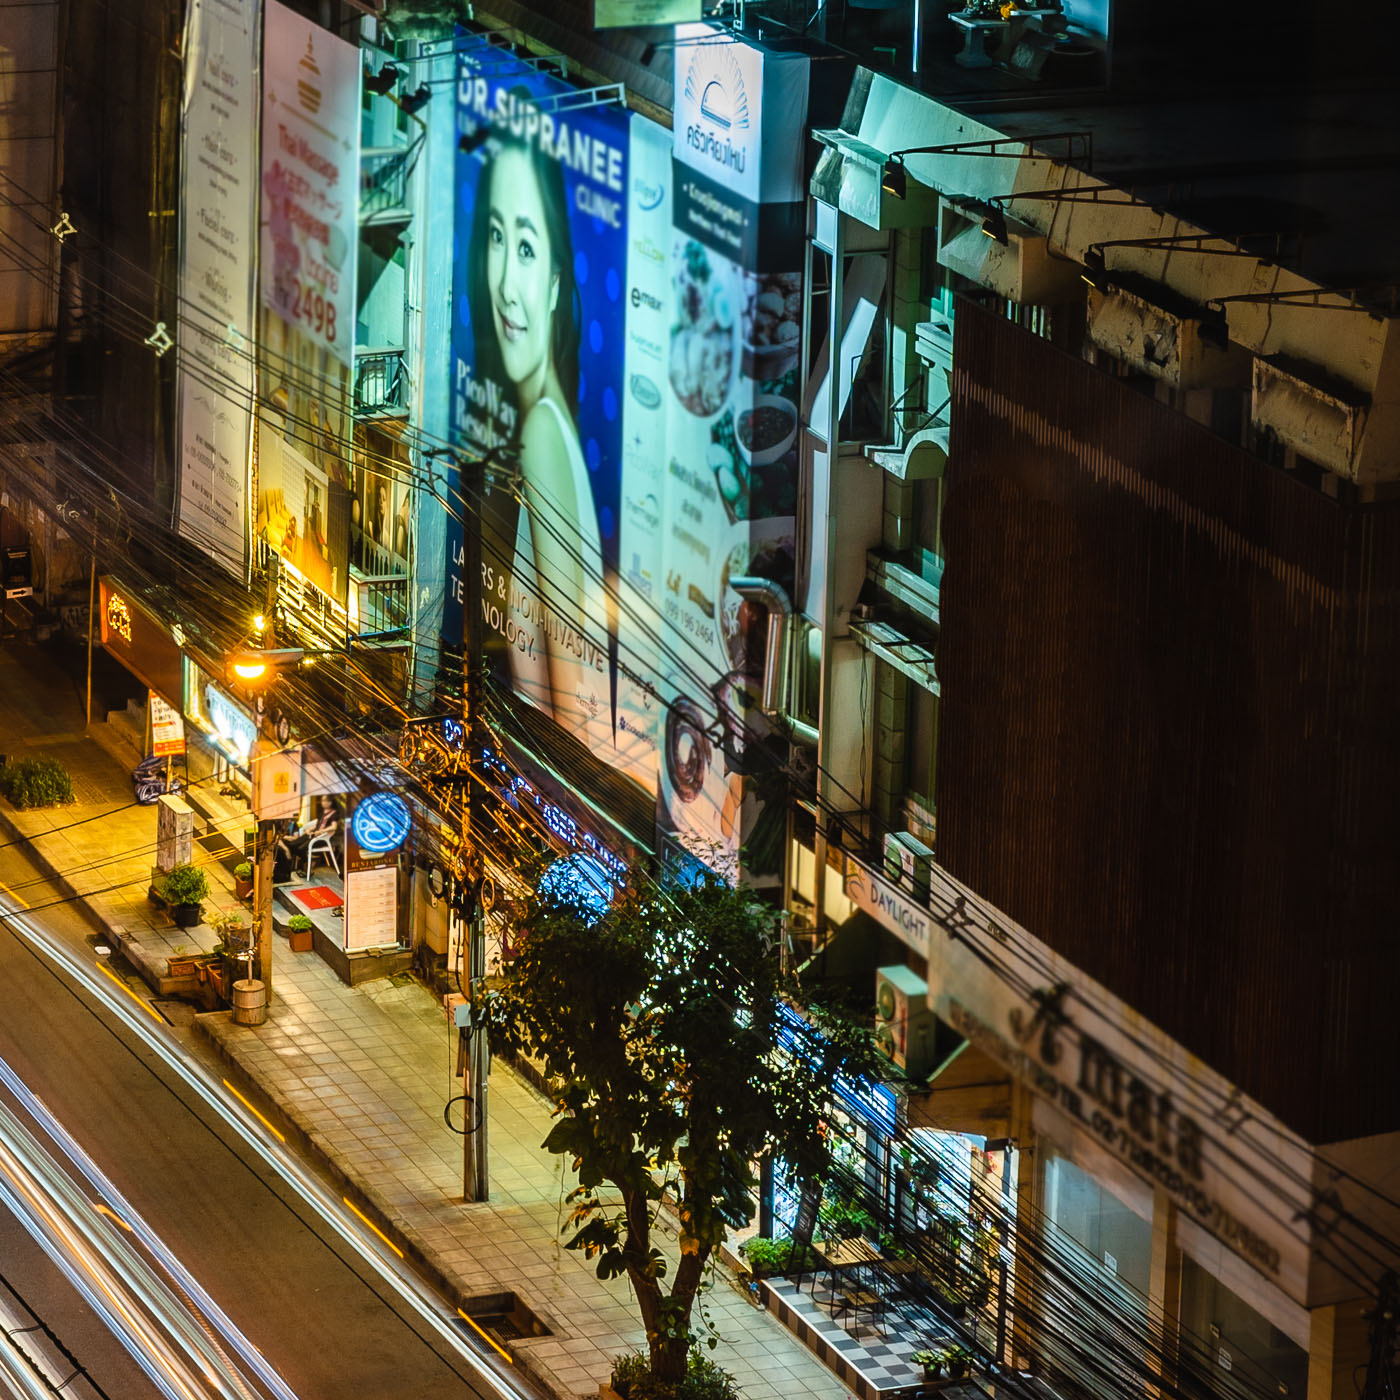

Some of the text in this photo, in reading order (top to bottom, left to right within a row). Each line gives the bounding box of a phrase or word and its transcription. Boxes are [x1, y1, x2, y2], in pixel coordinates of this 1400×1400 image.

[576, 183, 622, 230] CLINIC
[451, 573, 537, 662] TENOLOGY.
[452, 538, 605, 674] LARS & NON-INVASIVE
[870, 882, 927, 942] DAYLIGHT
